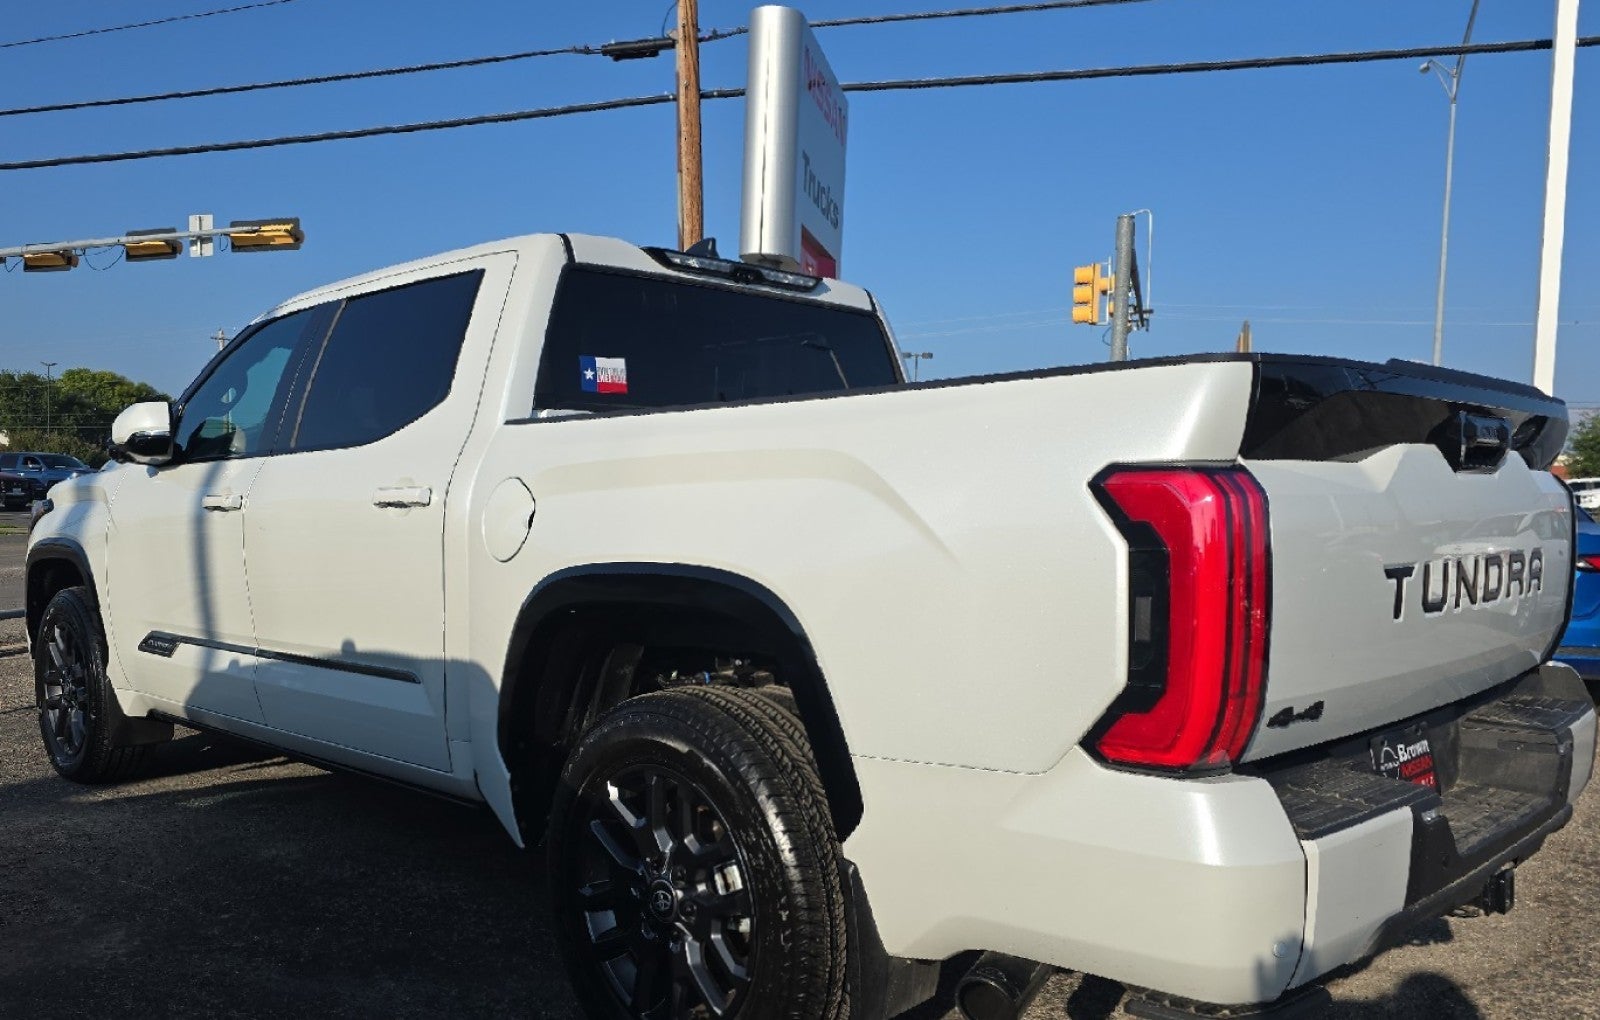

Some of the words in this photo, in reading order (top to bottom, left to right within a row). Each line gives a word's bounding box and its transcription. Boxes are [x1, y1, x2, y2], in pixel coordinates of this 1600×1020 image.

[802, 150, 840, 229] Trucks
[1384, 547, 1543, 620] TUNDRA
[1397, 740, 1430, 762] Brown
